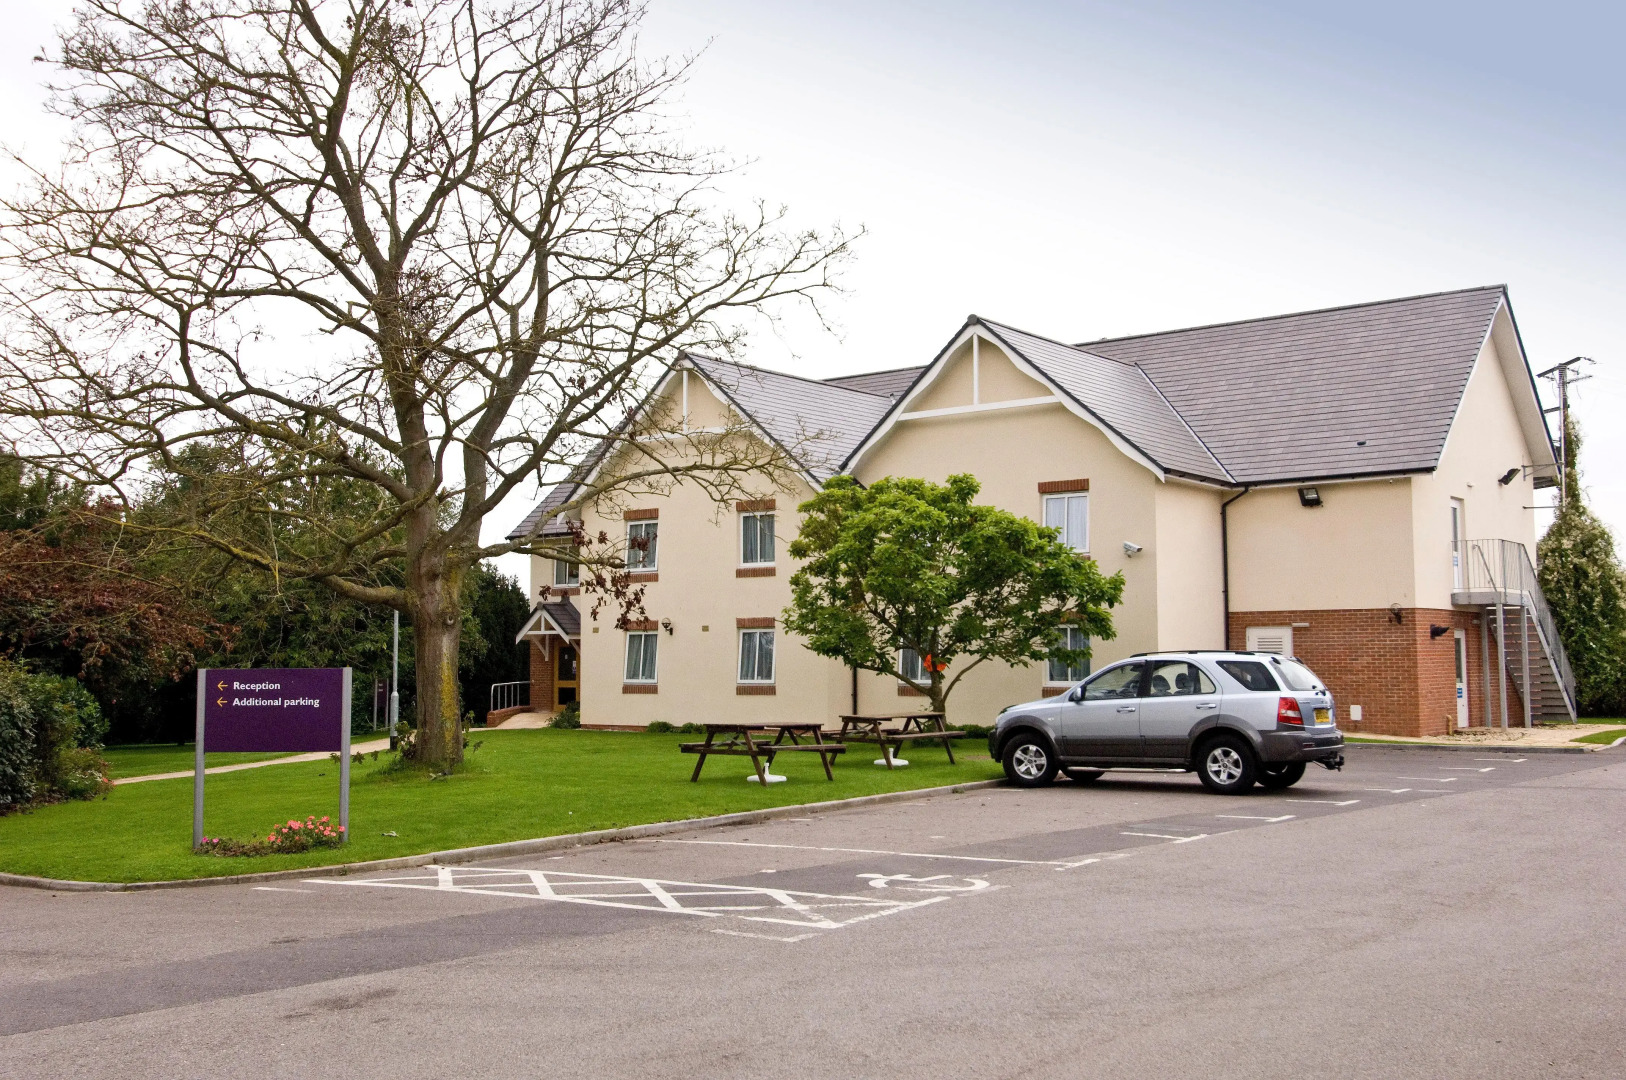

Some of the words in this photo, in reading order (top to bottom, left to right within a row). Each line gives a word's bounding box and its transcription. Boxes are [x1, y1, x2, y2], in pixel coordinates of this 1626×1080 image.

[233, 681, 281, 692] Reception
[232, 697, 282, 706] Additional
[284, 697, 320, 708] parking
